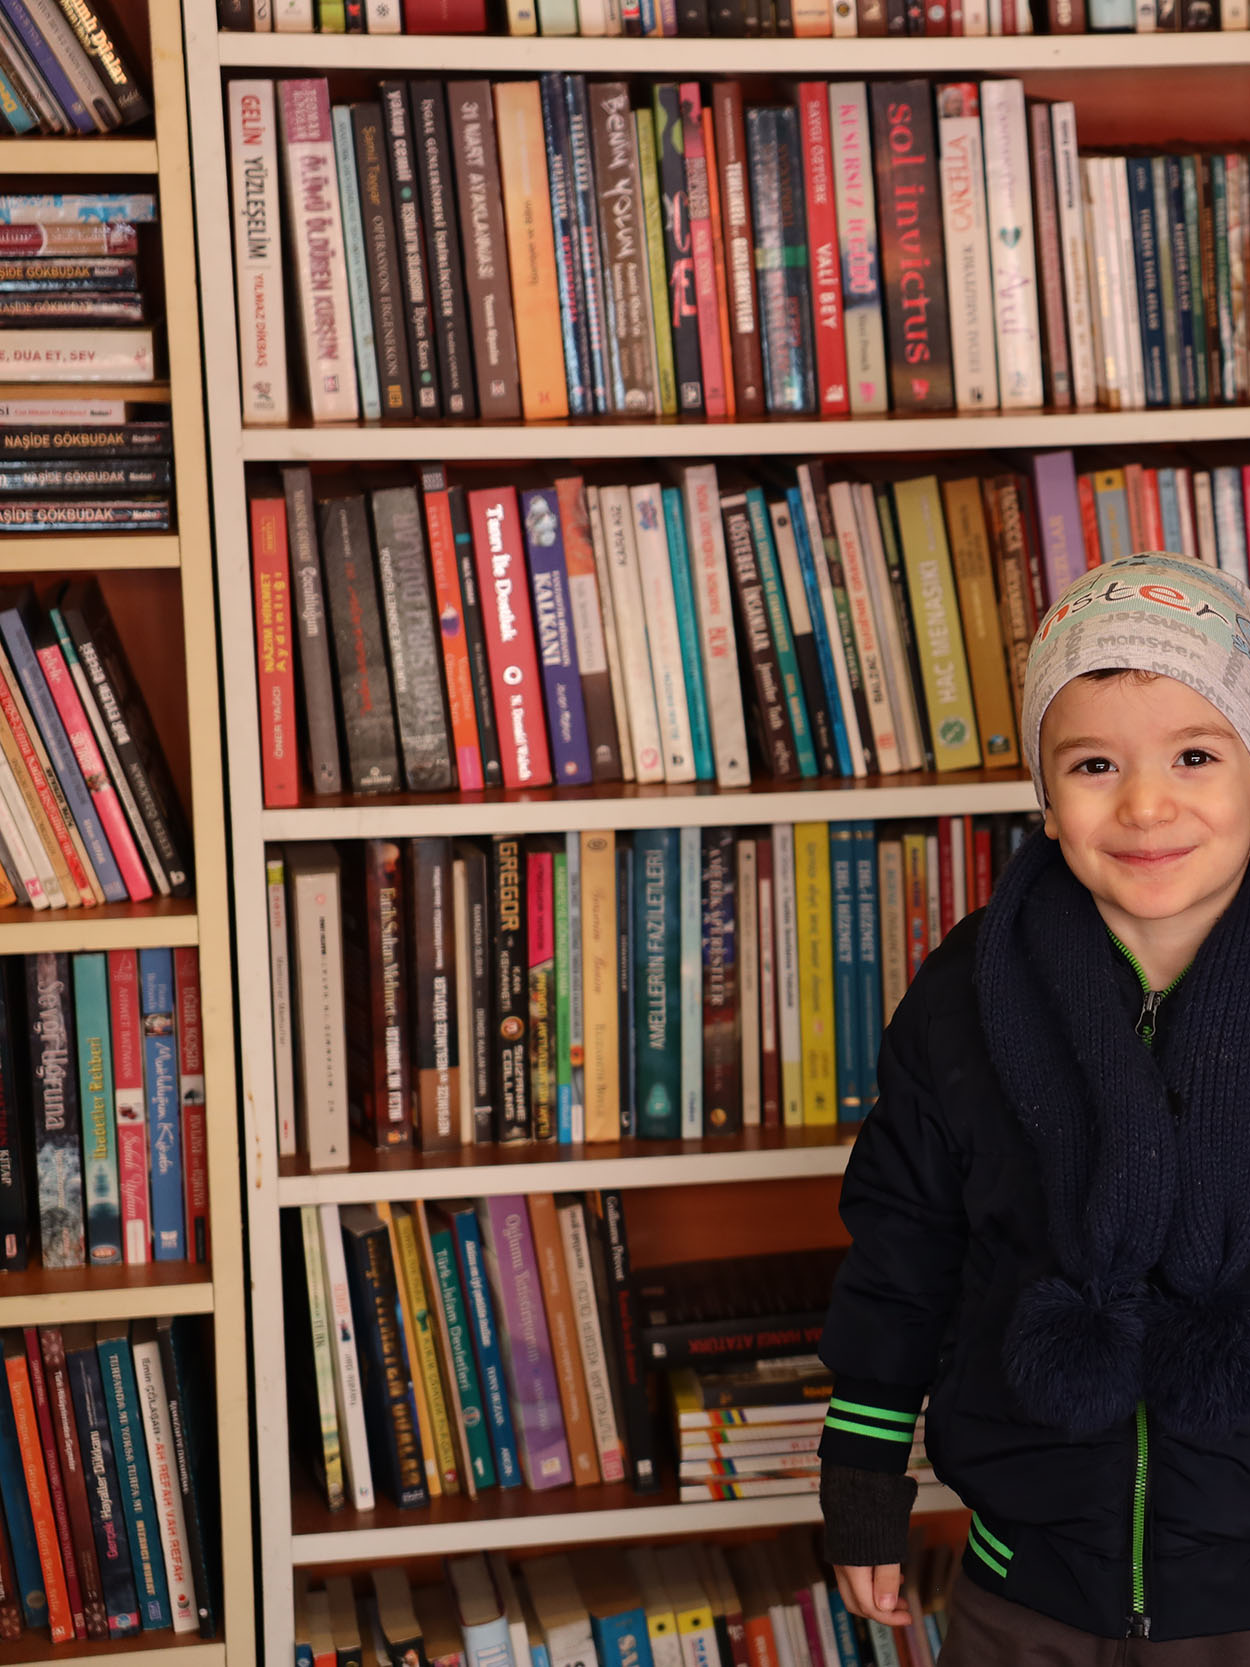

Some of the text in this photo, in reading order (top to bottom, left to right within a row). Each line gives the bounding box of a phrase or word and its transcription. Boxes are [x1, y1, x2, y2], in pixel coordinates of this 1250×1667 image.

[462, 123, 484, 166] MART
[839, 103, 865, 211] KUSURSUZ
[240, 94, 272, 260] GELİN YÜZLEŞELİM
[887, 103, 932, 363] sol invictus
[27, 264, 90, 278] GÖKBUDAK
[814, 243, 839, 285] VALİ
[372, 215, 400, 376] OPERASYON ERGENEKON
[819, 292, 839, 329] BEY
[13, 350, 42, 361] DUA
[70, 350, 96, 361] SEV
[5, 432, 125, 449] NAŞİDE GÖKBUDAK
[65, 469, 125, 482] GÖKBUDAK
[38, 504, 114, 523] GÖKBUDAK
[485, 504, 506, 552] Tanrı
[727, 513, 770, 653] KÖSTEBEK İNSANLAR
[493, 579, 518, 642] Dostluk
[533, 572, 561, 667] KALKANI
[932, 662, 959, 704] HAC
[379, 887, 398, 920] Fatih
[498, 841, 519, 932] GREGOR
[380, 920, 400, 962] Sultan
[645, 849, 667, 1051] AMELLERİN FAZİLETLERİ
[382, 963, 400, 1016] Mehmet
[502, 1048, 515, 1120] COLLINS
[513, 1044, 526, 1121] SUZANNE
[153, 1441, 168, 1461] AH
[156, 1463, 174, 1509] REFAH
[162, 1510, 178, 1536] VAH
[168, 1538, 185, 1582] REFAH
